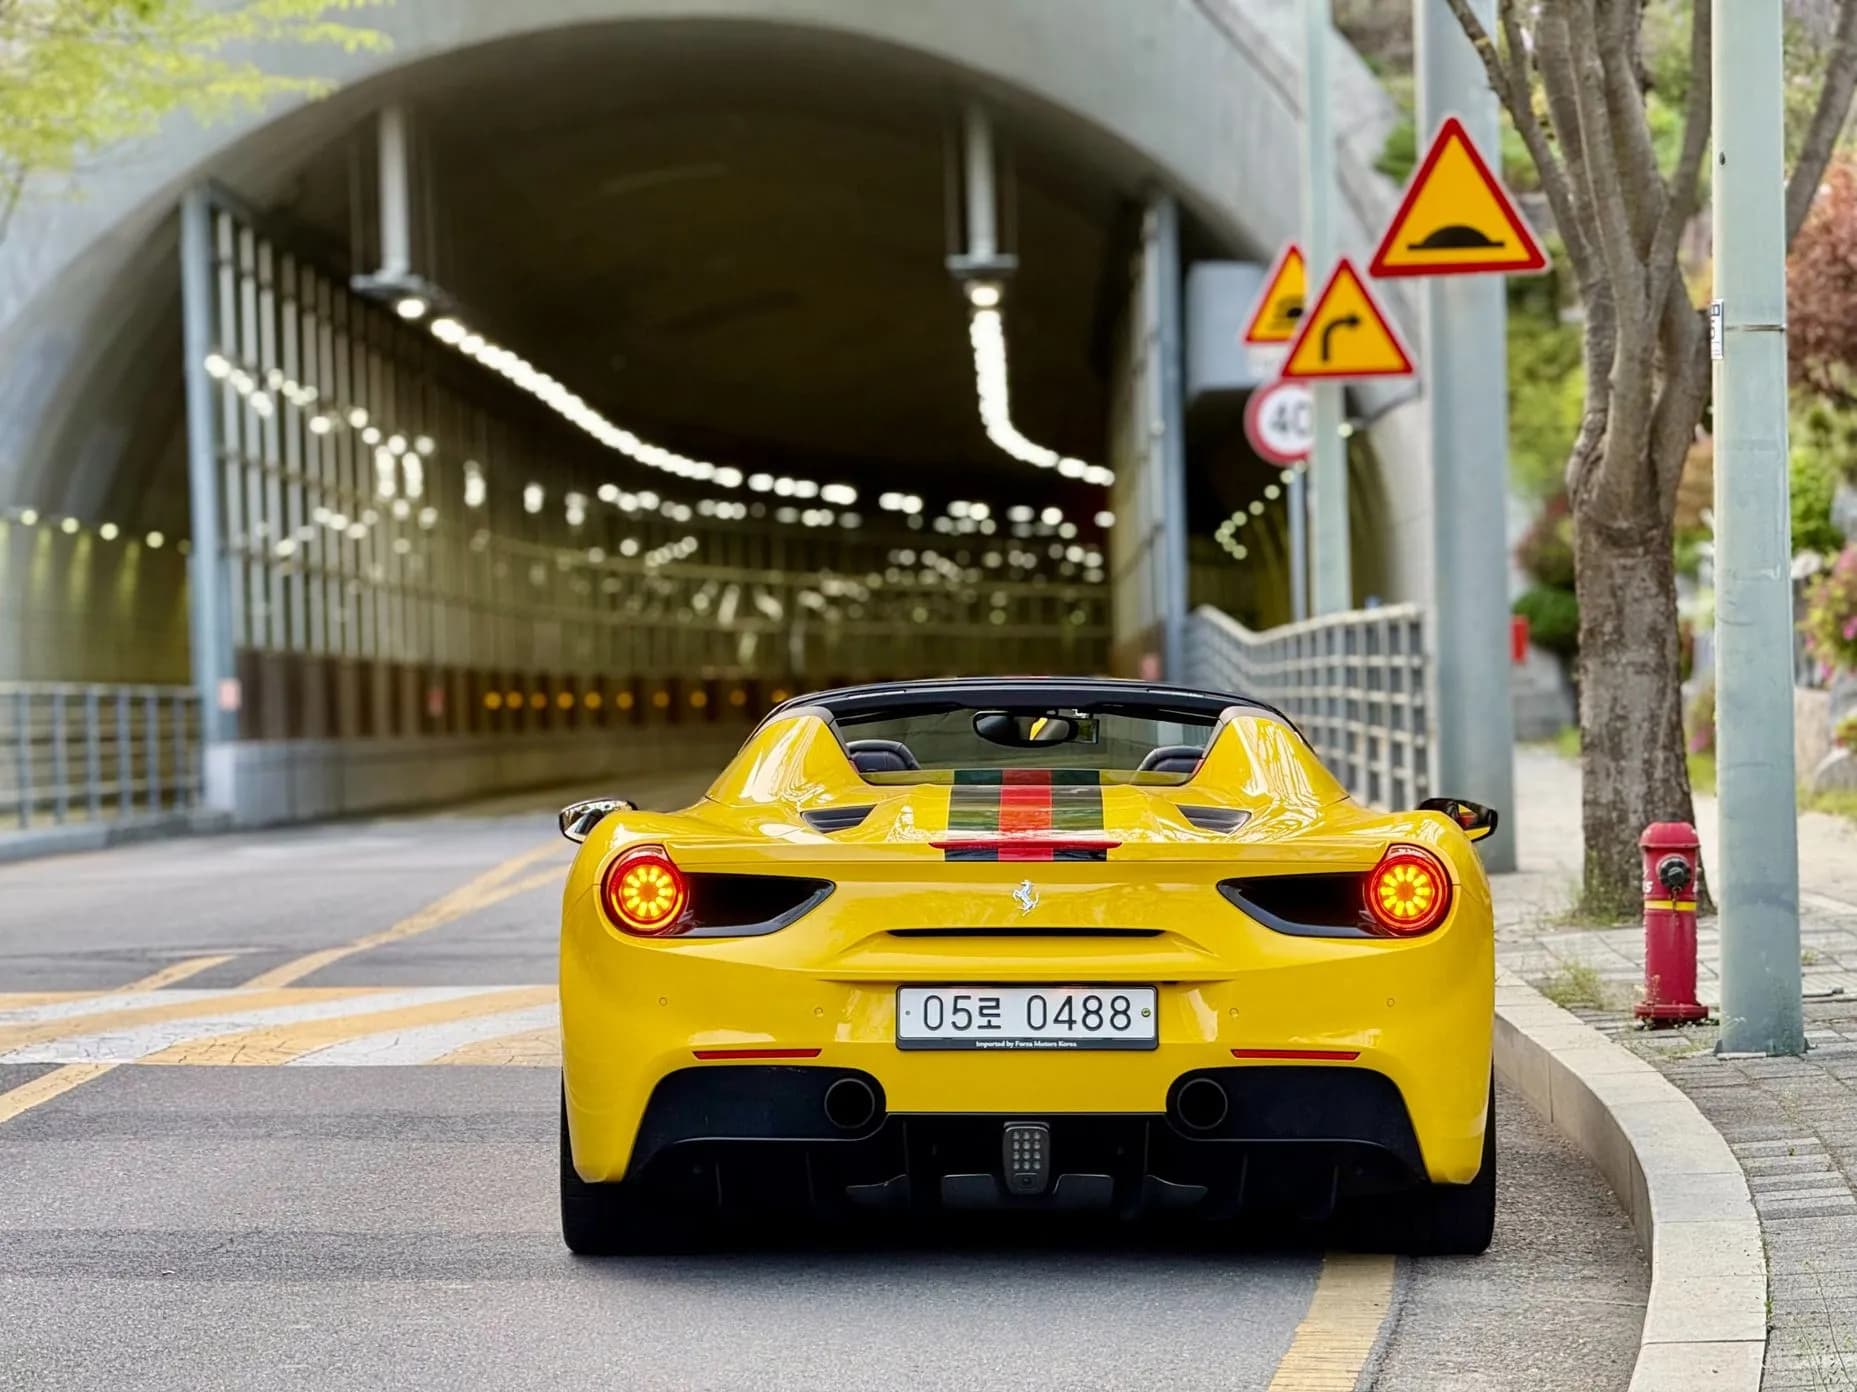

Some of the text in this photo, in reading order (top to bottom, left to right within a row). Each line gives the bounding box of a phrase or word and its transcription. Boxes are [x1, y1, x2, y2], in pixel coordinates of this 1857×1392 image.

[923, 995, 1132, 1031] 05로 0488
[976, 1041, 1005, 1049] Imported
[1006, 1041, 1014, 1049] by
